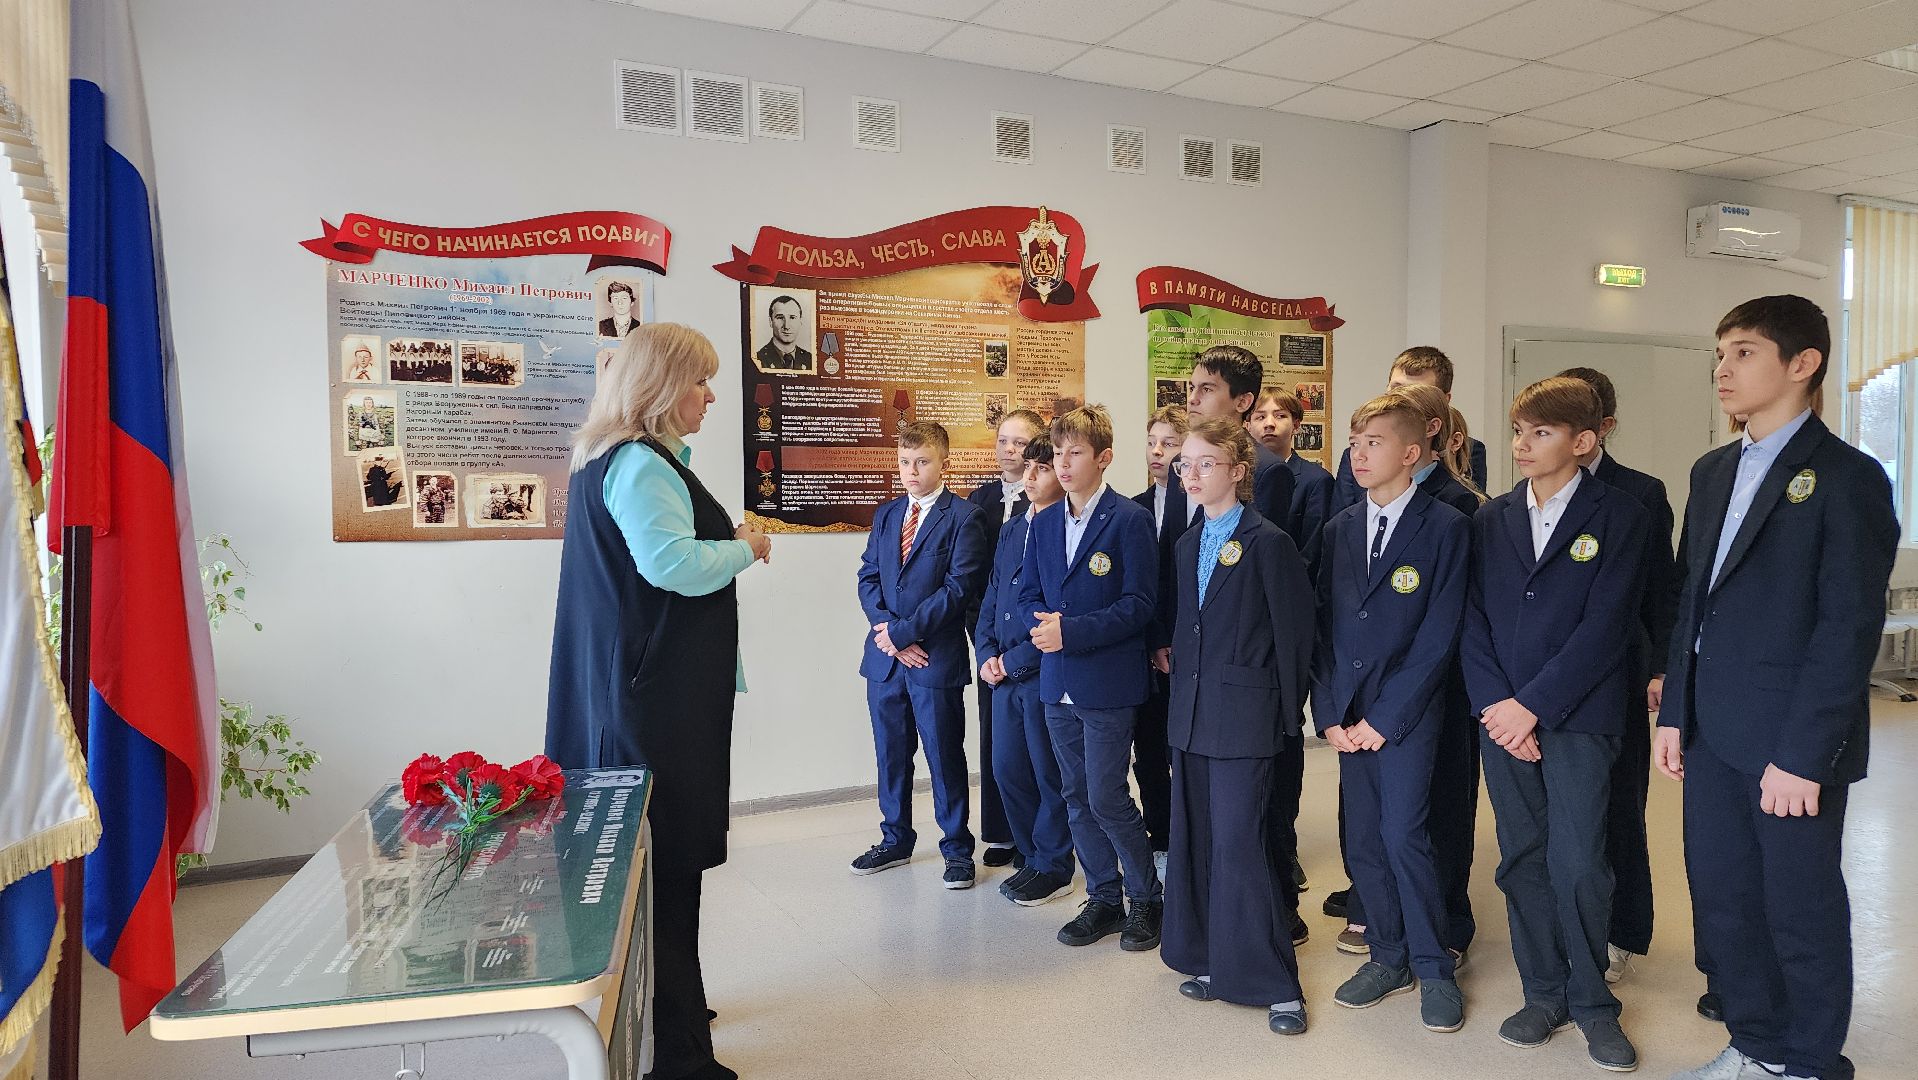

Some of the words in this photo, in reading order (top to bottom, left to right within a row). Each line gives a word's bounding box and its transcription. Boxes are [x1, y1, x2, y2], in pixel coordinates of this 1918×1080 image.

[353, 222, 371, 237] С
[378, 227, 430, 250] ЧЕГО
[437, 229, 572, 252] НАЧИНАЕТСЯ
[577, 225, 660, 247] ПОДВИГ
[778, 241, 865, 269] ПОЛЬЗА,
[871, 238, 935, 263] ЧЕСТЬ,
[941, 229, 1007, 251] СЛАВА
[337, 269, 449, 290] МАРЧЕНКО
[452, 278, 516, 295] Михаил
[520, 283, 593, 301] Петрович
[1150, 282, 1158, 295] В
[1165, 281, 1226, 303] ПАМЯТИ
[1231, 294, 1319, 318] НАВСЕГДА...
[410, 303, 448, 312] Петрович
[489, 308, 507, 316] 1969
